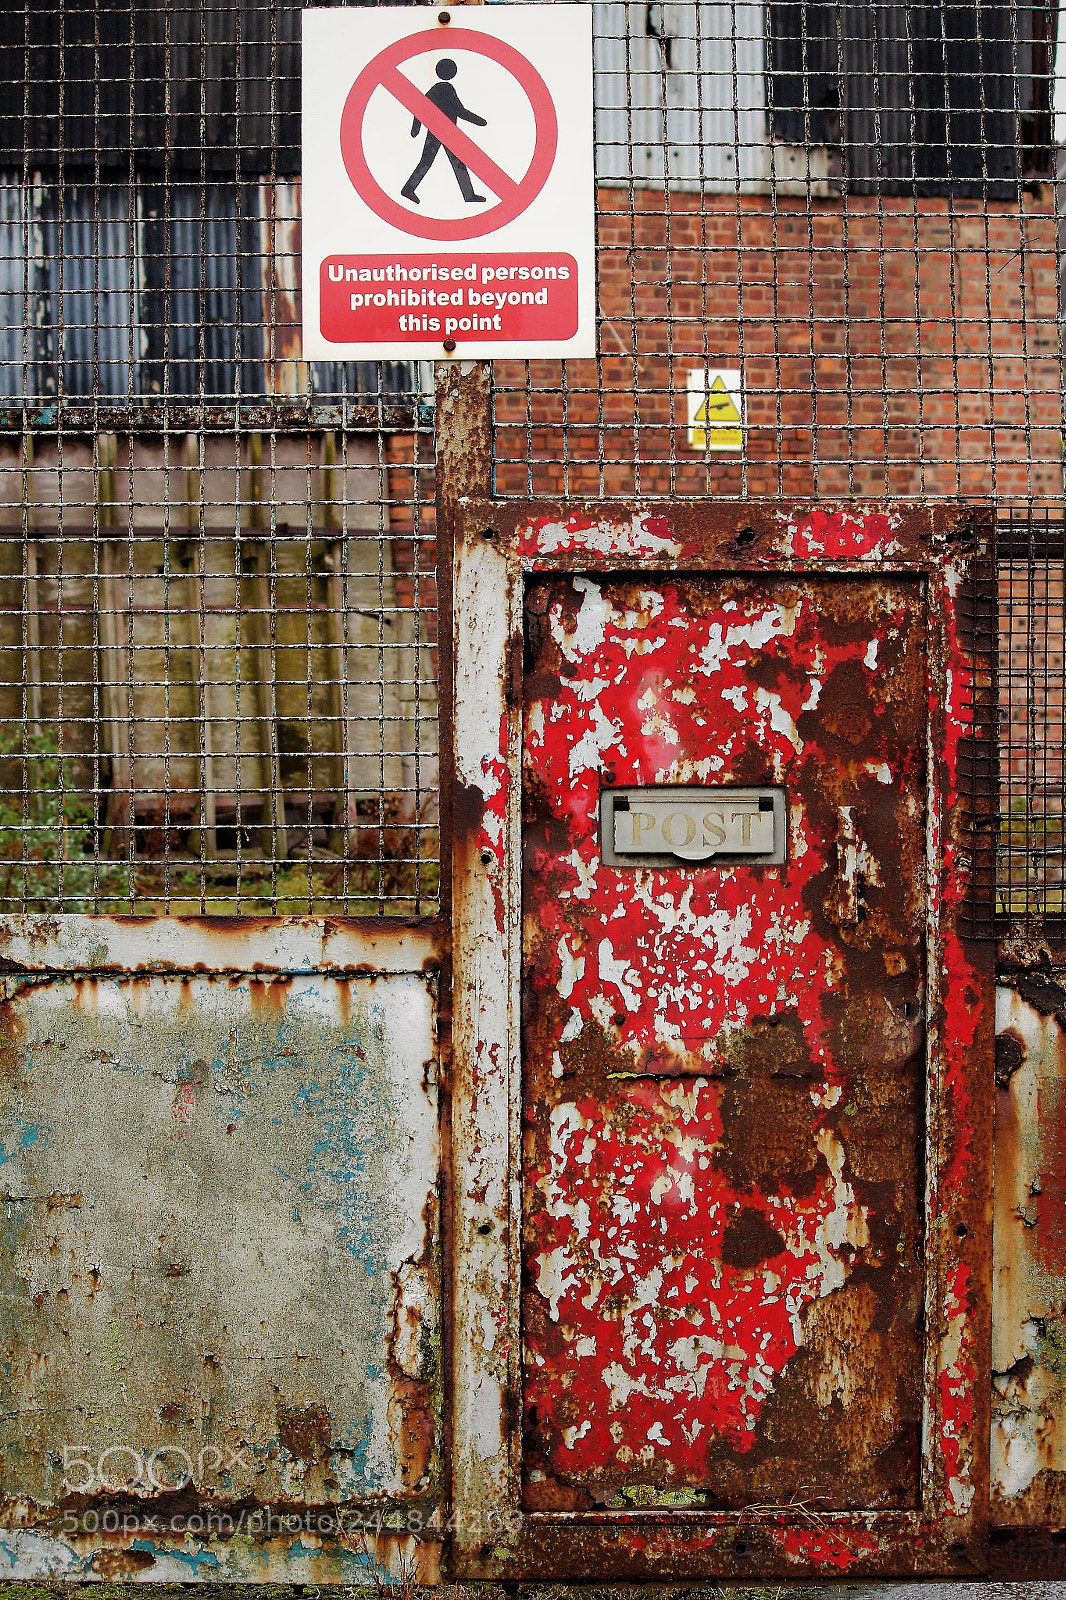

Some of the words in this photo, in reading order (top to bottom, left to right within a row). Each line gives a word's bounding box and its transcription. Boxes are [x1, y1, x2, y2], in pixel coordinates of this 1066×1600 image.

[328, 264, 477, 282] Unauthorised
[481, 266, 570, 284] persons
[350, 289, 463, 311] prohibited
[468, 288, 548, 309] beyond
[398, 314, 441, 331] this
[445, 313, 502, 335] point
[630, 812, 762, 847] POST
